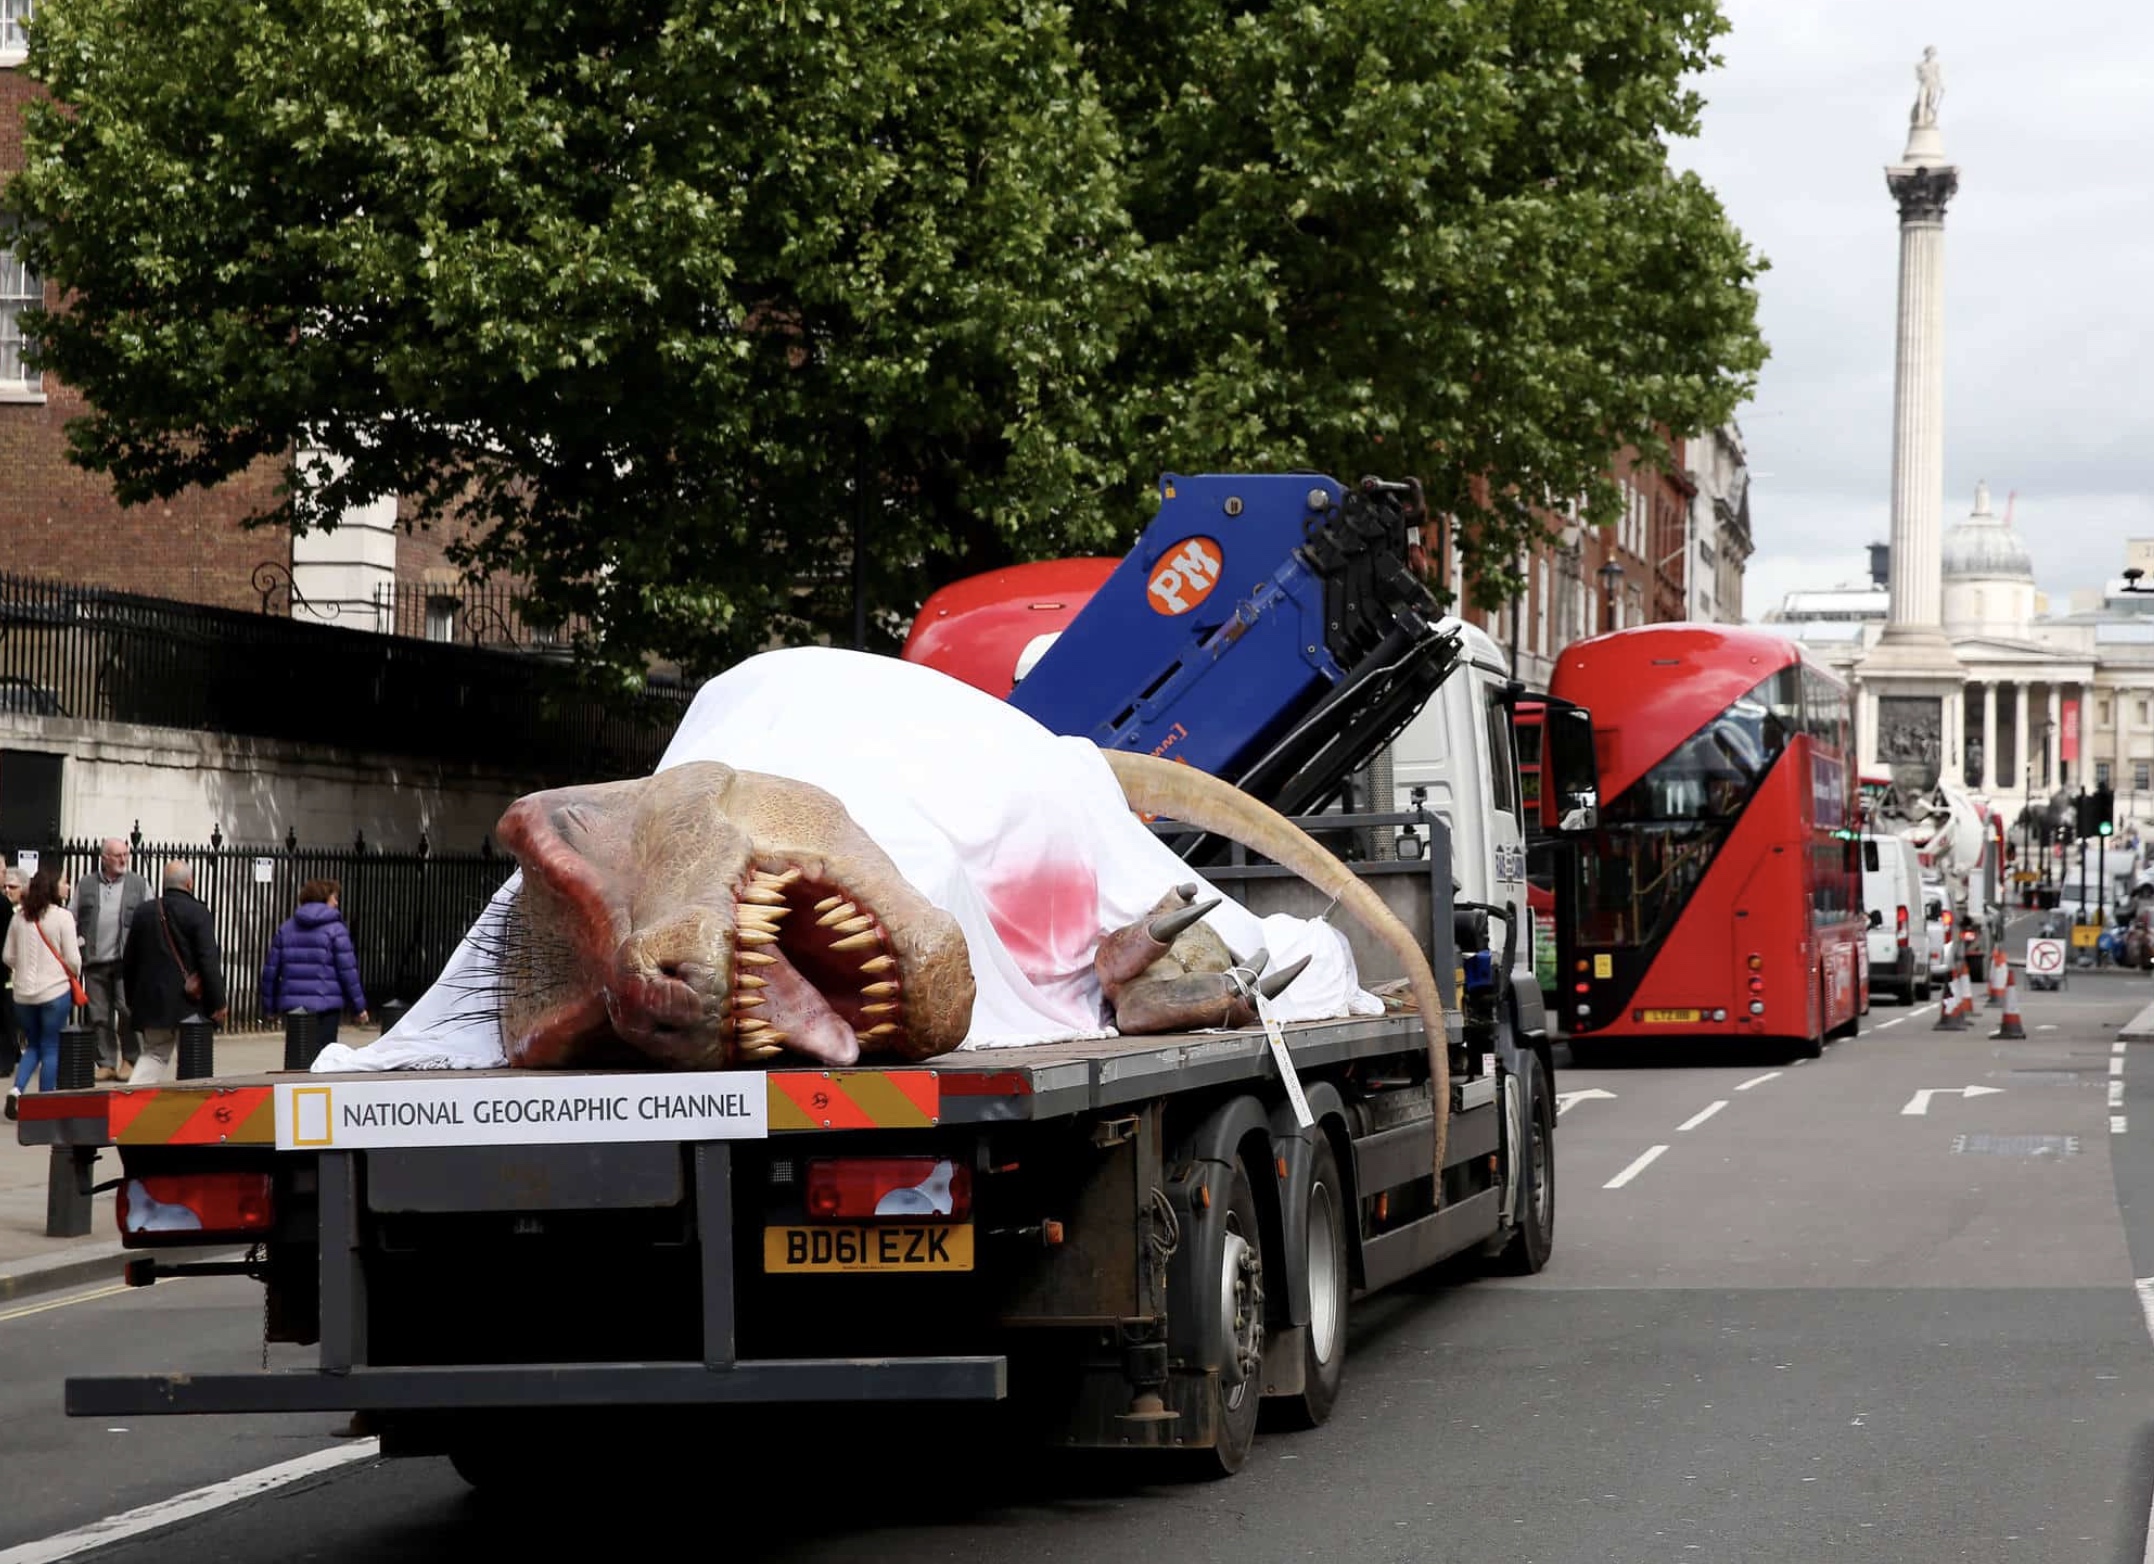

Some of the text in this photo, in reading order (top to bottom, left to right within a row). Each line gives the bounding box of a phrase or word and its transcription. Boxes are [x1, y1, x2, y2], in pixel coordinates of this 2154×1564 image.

[1148, 539, 1220, 614] PM
[343, 1093, 751, 1128] NATIONAL GEOGRAPHIC CHANNEL
[786, 1228, 950, 1265] BD61 EZK
